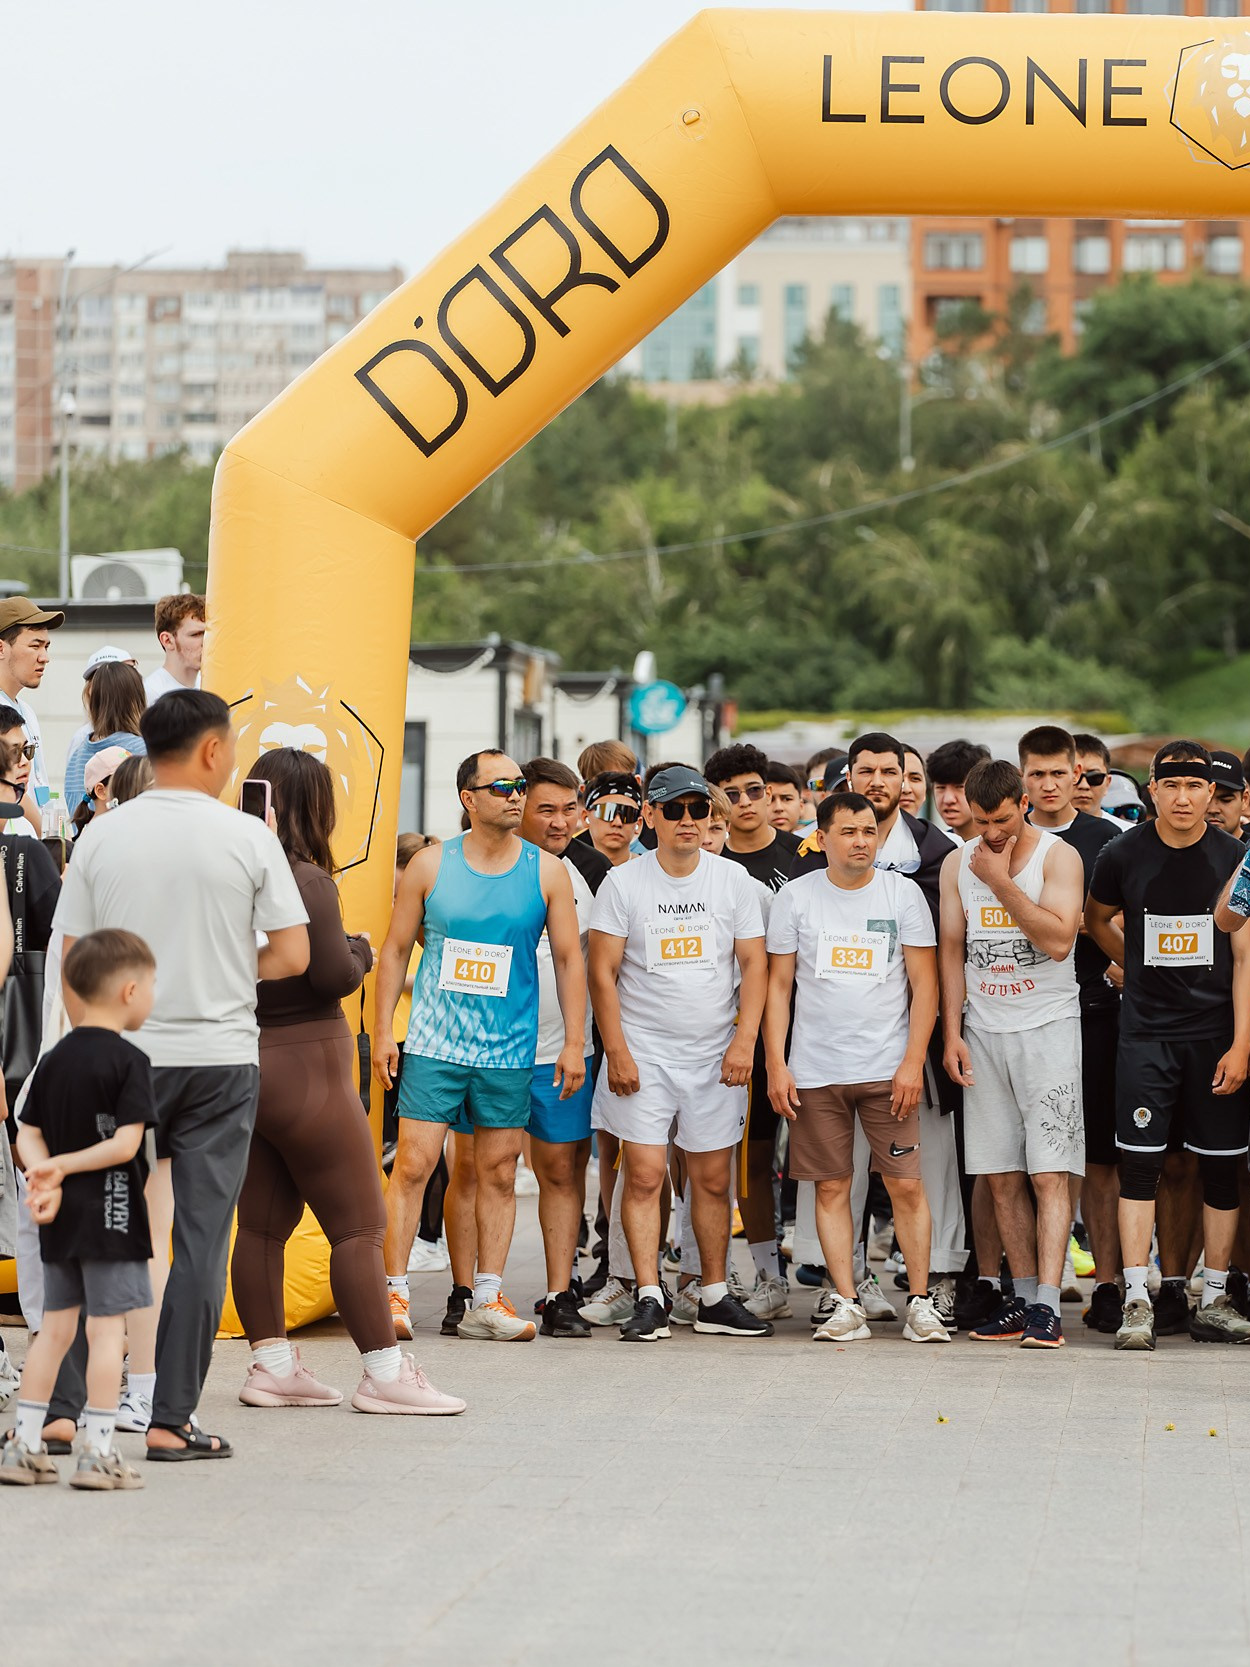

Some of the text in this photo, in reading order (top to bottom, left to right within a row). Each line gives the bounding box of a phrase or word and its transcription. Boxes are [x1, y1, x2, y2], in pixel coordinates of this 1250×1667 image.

[821, 55, 1148, 128] LEONE
[354, 144, 670, 458] D'ORO
[16, 853, 25, 893] Calvin Klein
[651, 926, 675, 935] LEONE
[1151, 921, 1173, 929] LEONE
[664, 939, 698, 957] 412
[824, 935, 849, 943] LEONE
[1161, 935, 1195, 952] 407
[449, 946, 472, 955] LEONE
[835, 949, 869, 967] 334
[457, 962, 491, 981] 410
[991, 964, 1015, 973] AGAIN
[979, 979, 1036, 997] ROUND
